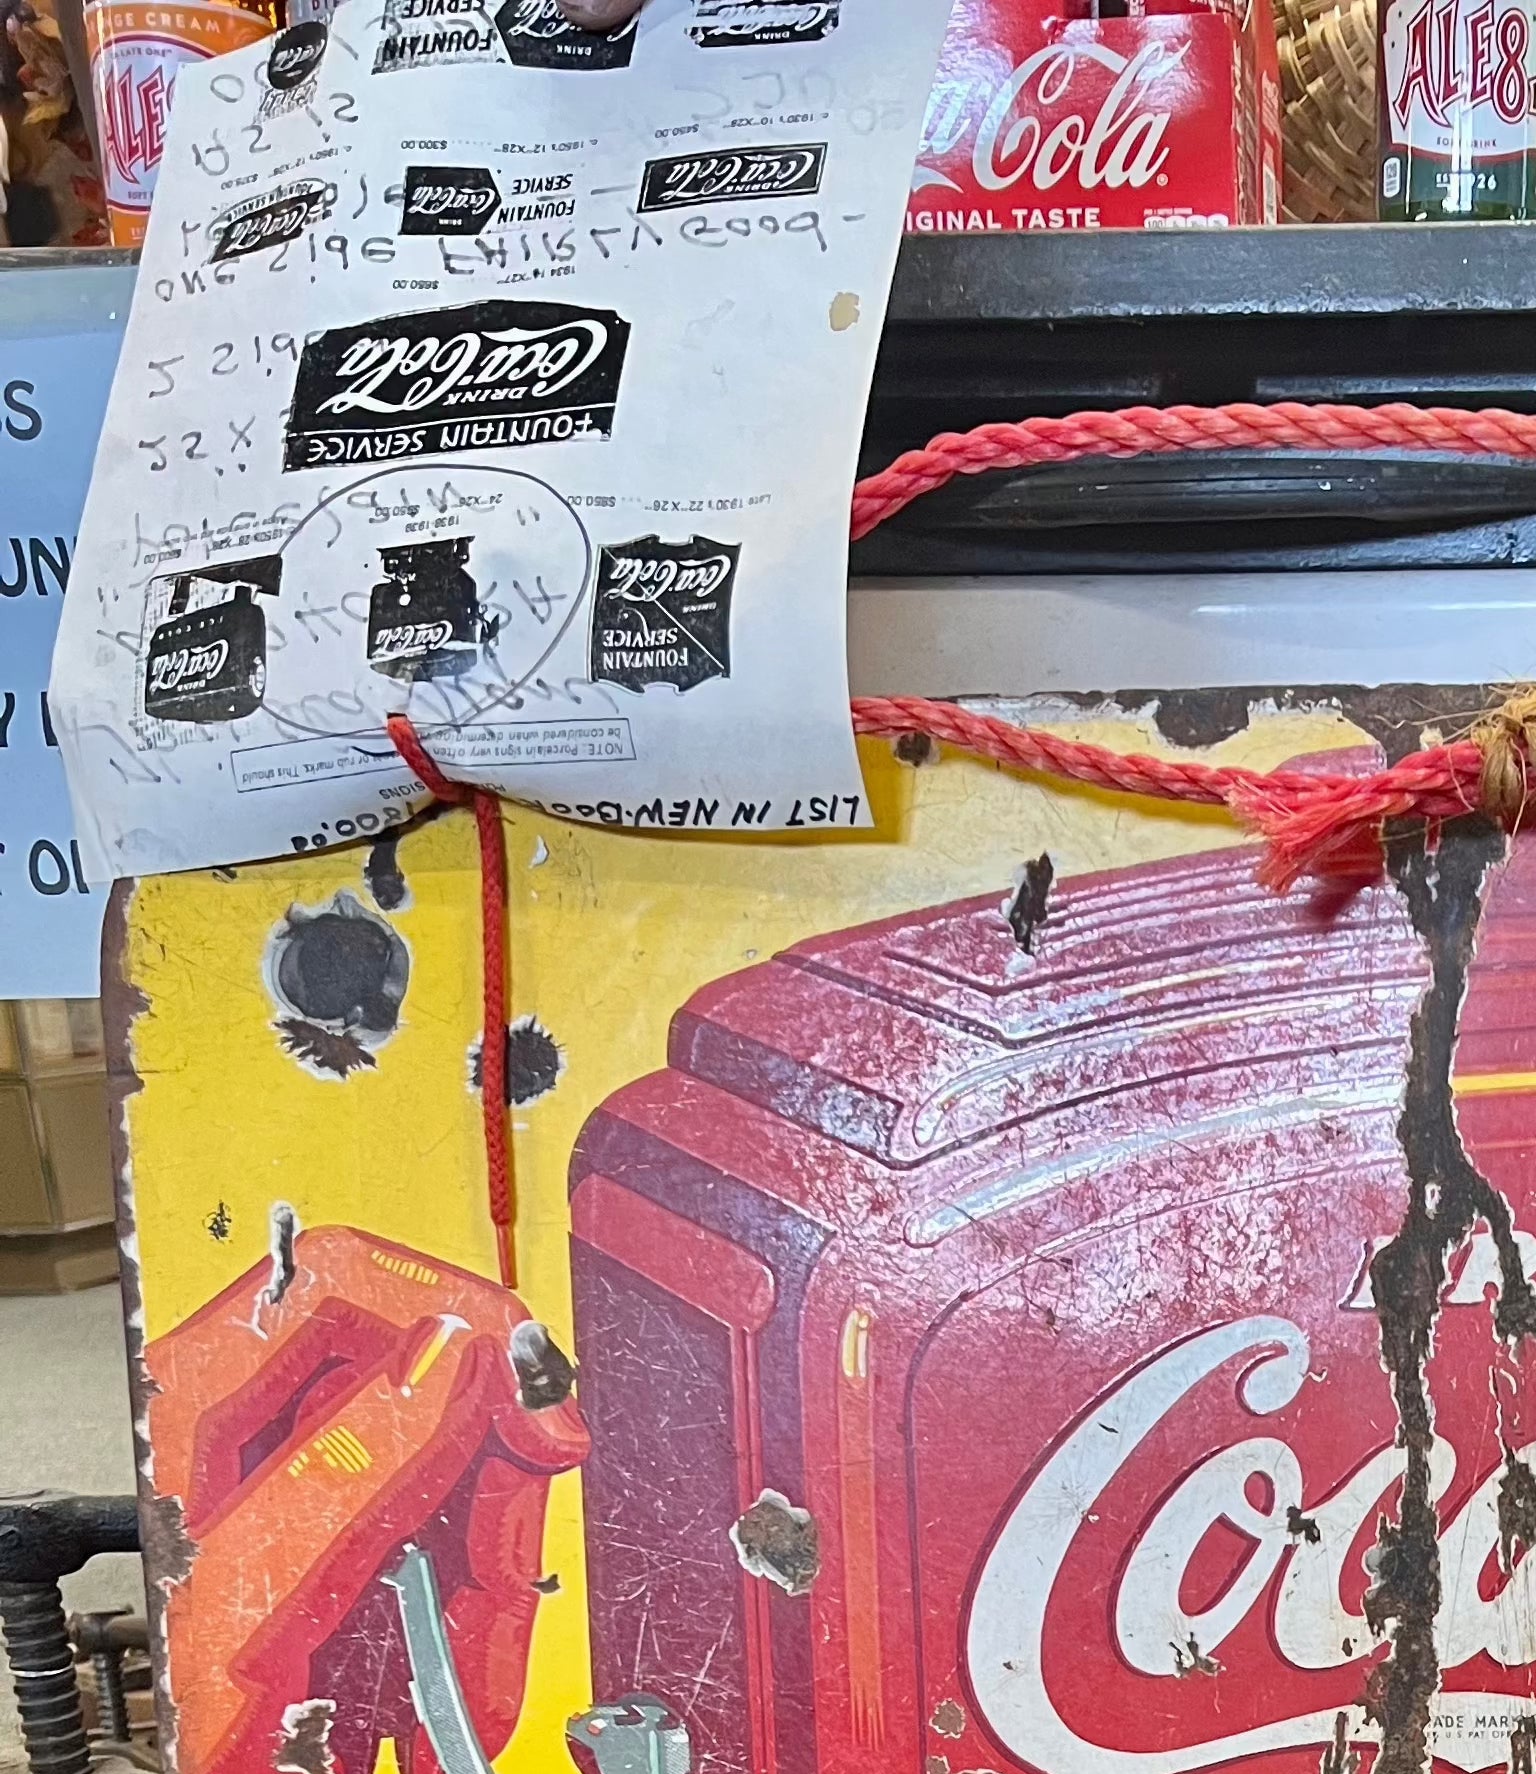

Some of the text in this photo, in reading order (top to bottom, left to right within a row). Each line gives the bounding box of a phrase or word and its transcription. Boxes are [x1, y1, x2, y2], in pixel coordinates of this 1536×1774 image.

[145, 12, 221, 33] CREAM
[381, 28, 494, 61] FOUNTAIN
[556, 43, 592, 57] DRINK
[400, 139, 448, 151] $300.00
[511, 173, 573, 195] SERVICE
[497, 200, 575, 224] FOUNTAIN
[1012, 208, 1100, 229] TASTE
[442, 385, 529, 406] DRINK
[306, 411, 593, 463] FOUNTAIN SERVICE
[602, 626, 678, 648] SERVICE
[602, 646, 688, 670] FOUNTAIN
[508, 731, 539, 744] when
[542, 728, 604, 743] considered
[607, 727, 622, 740] be
[433, 746, 466, 759] often
[469, 745, 492, 758] very
[494, 743, 522, 759] signs
[525, 743, 578, 759] Porcelain
[242, 770, 275, 784] should
[277, 765, 300, 781] This
[378, 781, 425, 800] SIGNS
[732, 801, 772, 827] IN
[786, 795, 860, 827] LIST
